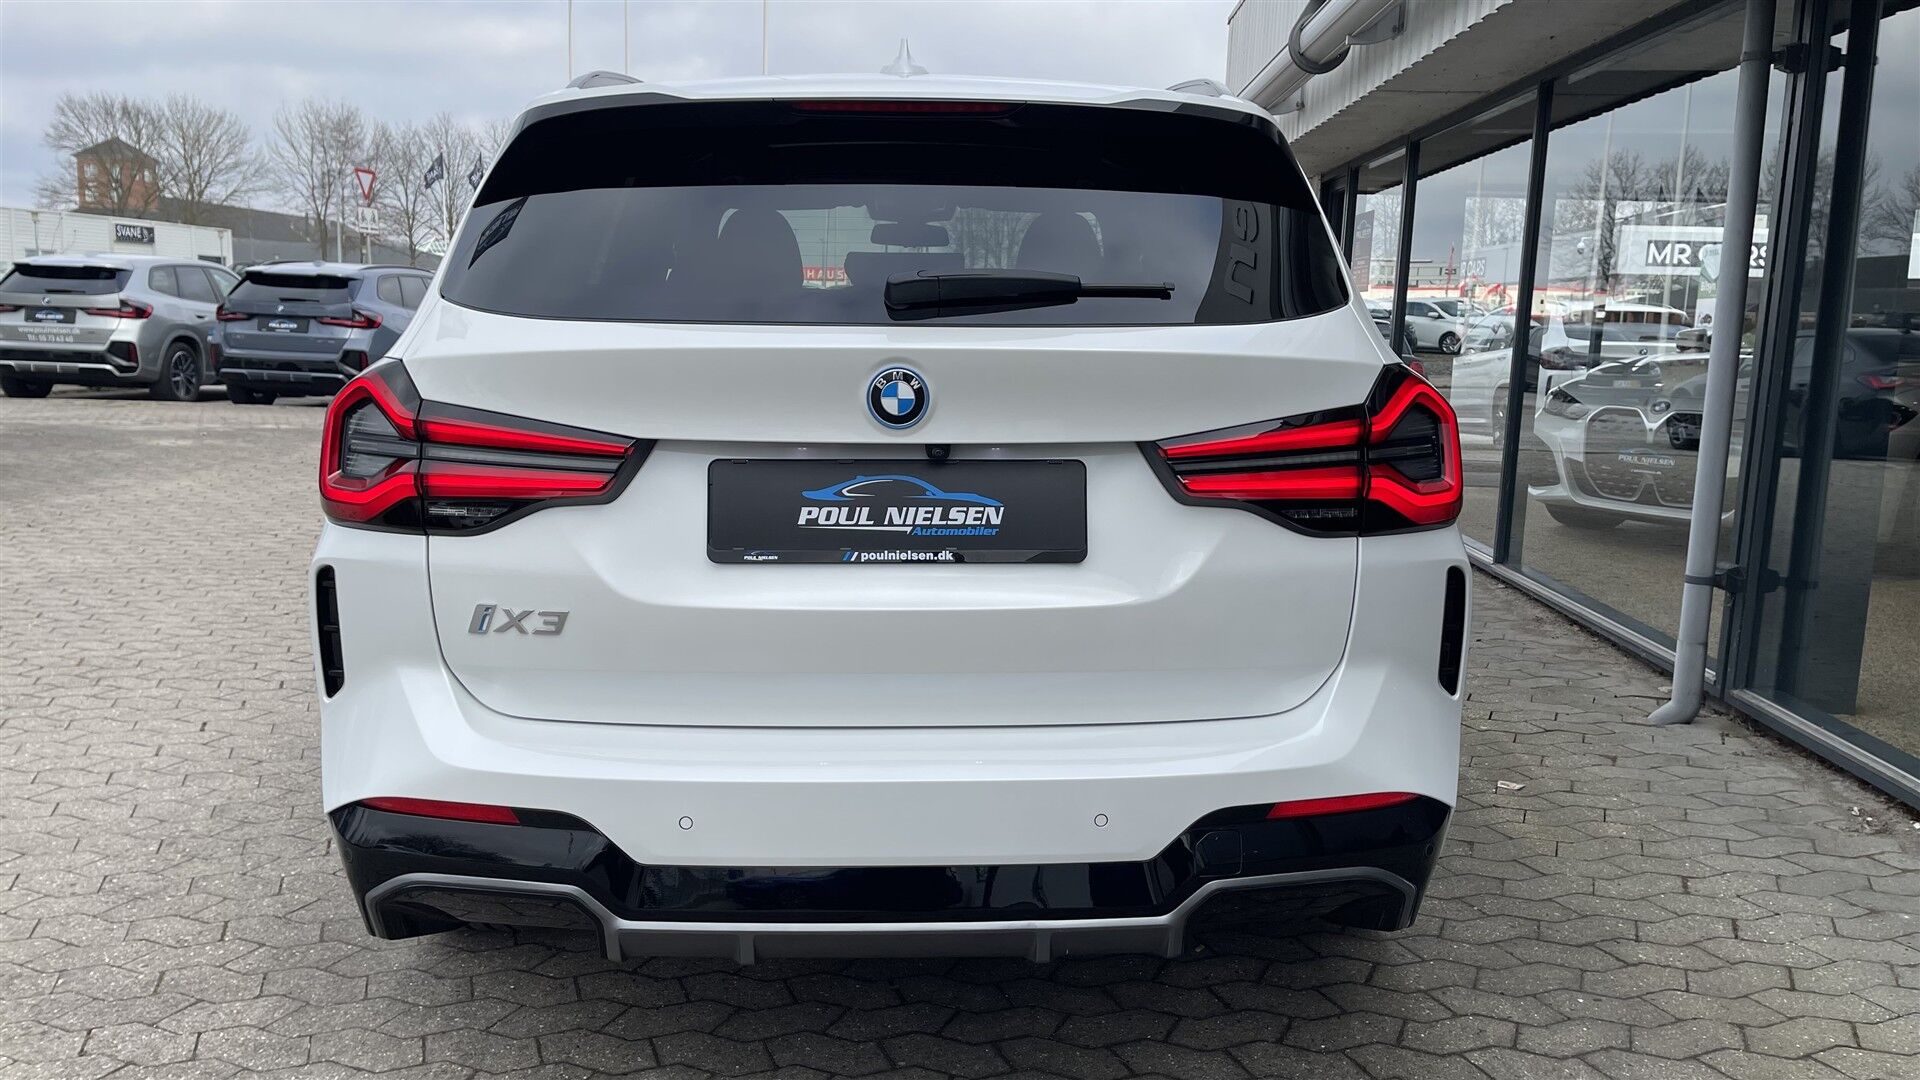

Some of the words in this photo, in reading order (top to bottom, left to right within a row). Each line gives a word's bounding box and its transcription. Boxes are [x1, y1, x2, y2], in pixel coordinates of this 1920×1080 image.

[116, 224, 142, 239] SVANE
[1647, 242, 1691, 265] MR
[875, 371, 921, 390] BMW
[797, 506, 875, 526] POUL
[883, 506, 1005, 526] NIELSEN
[911, 526, 1000, 537] Automobiler
[860, 550, 954, 562] poulnielsen.dk
[468, 603, 570, 636] iX3
